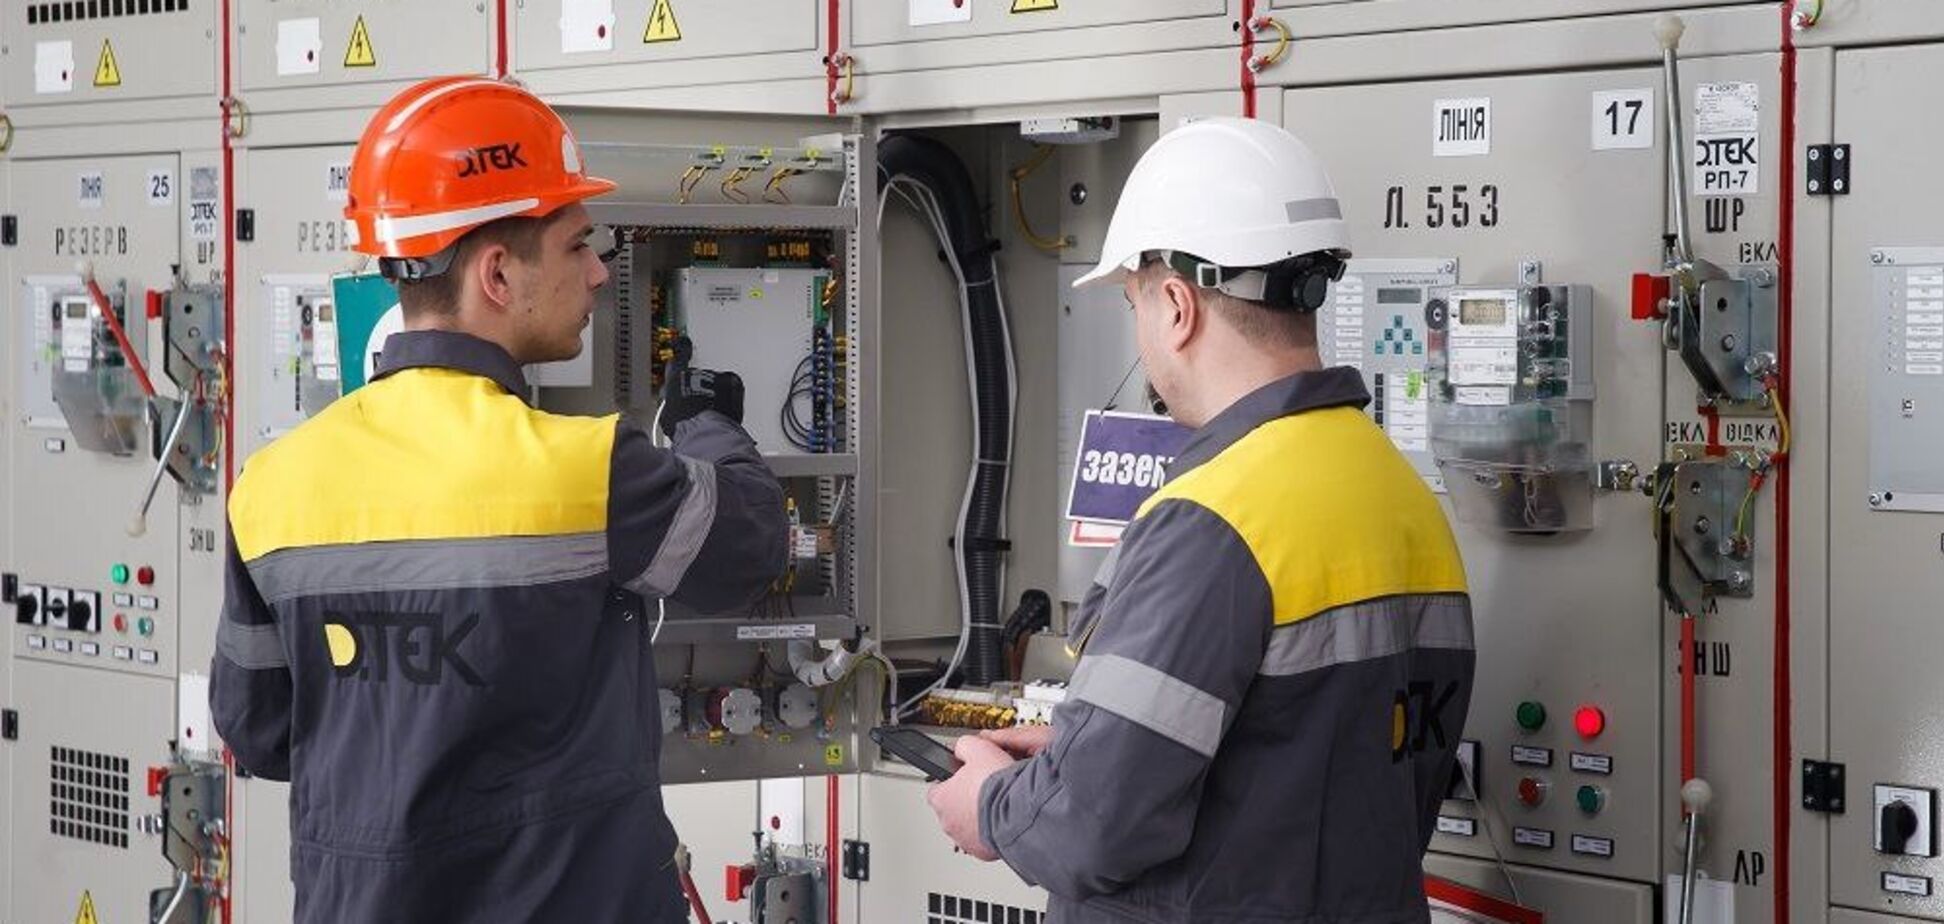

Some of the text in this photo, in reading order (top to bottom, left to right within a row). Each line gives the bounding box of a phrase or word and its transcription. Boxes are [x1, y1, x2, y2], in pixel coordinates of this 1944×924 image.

[1438, 106, 1486, 142] ЛІНІЯ
[1605, 100, 1643, 135] 17
[151, 175, 170, 198] 25
[1705, 171, 1749, 190] РП-7
[1426, 184, 1499, 228] 553
[55, 225, 128, 256] РЕЗЕРВ
[297, 221, 349, 252] РЕЗЕ
[1666, 421, 1706, 443] ВКЛ
